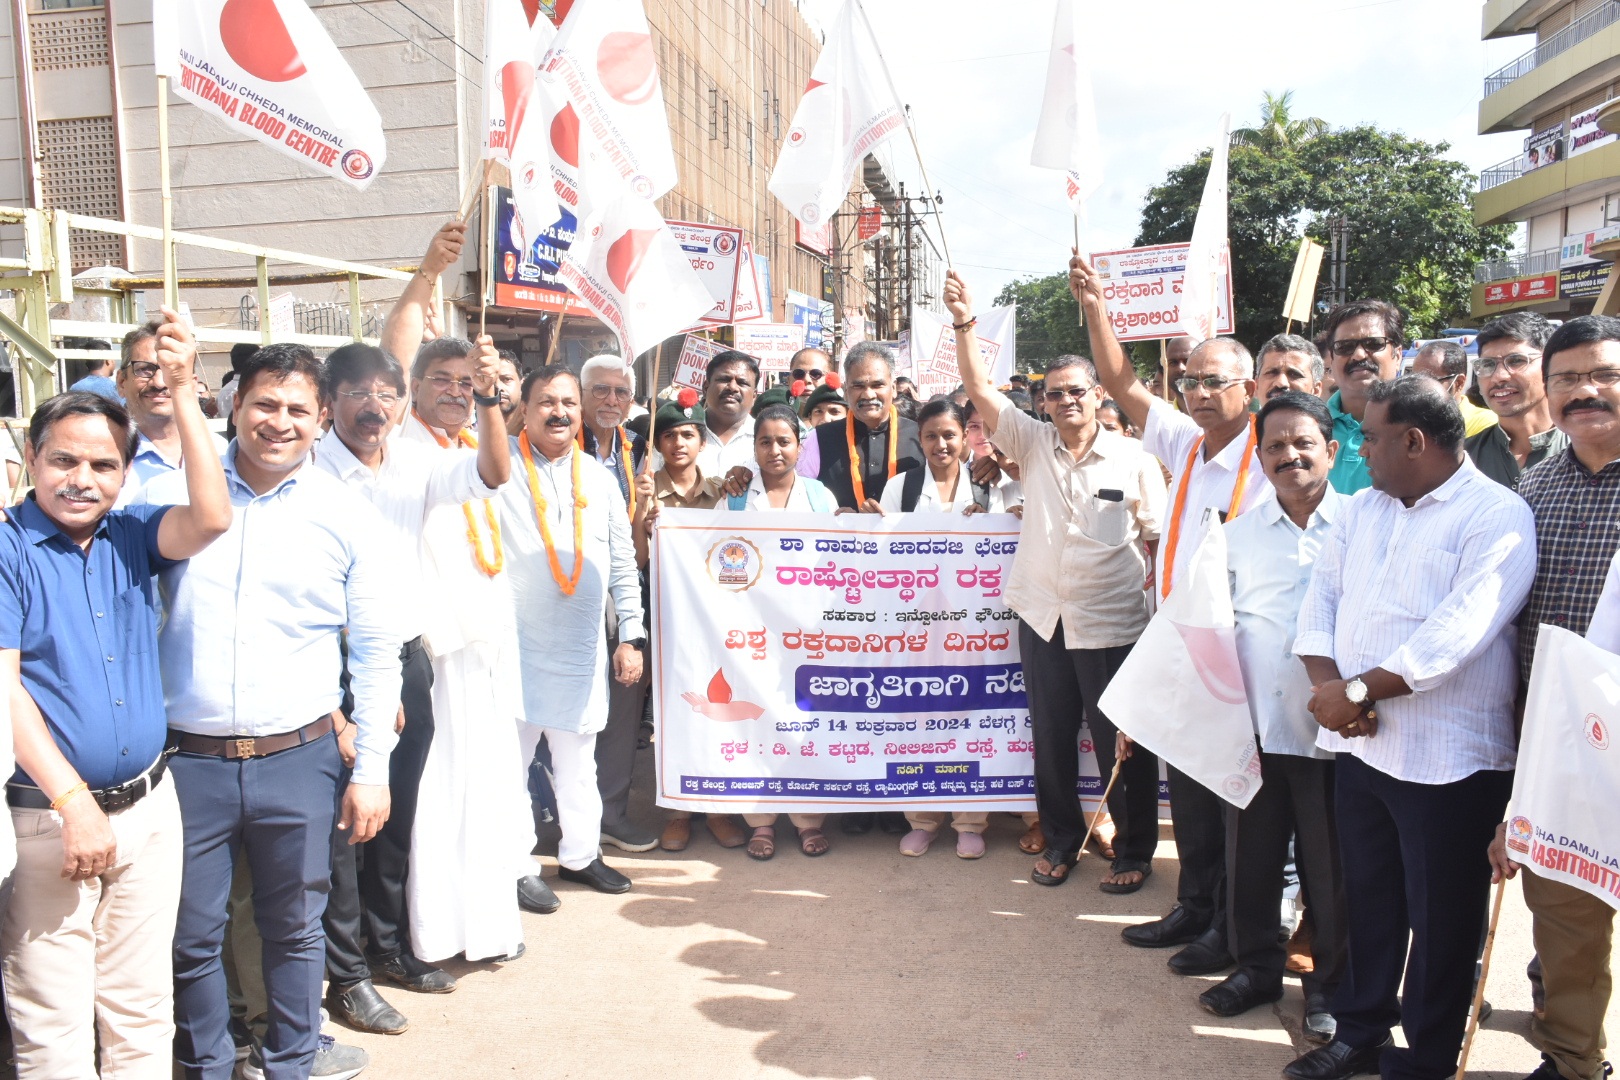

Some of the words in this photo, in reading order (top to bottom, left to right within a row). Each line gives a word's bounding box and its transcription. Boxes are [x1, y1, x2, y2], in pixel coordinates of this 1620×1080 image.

[180, 63, 240, 118] ROTTHANA
[239, 102, 287, 140] BLOOD
[285, 129, 340, 168] CENTRE
[195, 59, 237, 92] JADAVJI
[239, 86, 285, 118] CHHEDA
[287, 112, 344, 149] MEMORIAL
[581, 102, 608, 140] BLOOD
[601, 138, 635, 180] CENTRE
[1103, 277, 1164, 304] ರಕ್ತದಾನ
[920, 372, 947, 384] DONATE
[780, 538, 804, 551] ಶಾ
[815, 536, 878, 555] ದಾಮಜಿ
[889, 537, 964, 555] ಜಾದವಜಿ
[776, 561, 939, 605] ರಾಷ್ಟ್ರೋತ್ಥಾನ
[956, 563, 1002, 597] ರಕ್ತ
[823, 608, 876, 622] ಸಹಕಾರ
[724, 625, 767, 660] ವಿಶ್ವ
[782, 626, 928, 660] ರಕ್ತದಾನಿಗಳ
[943, 628, 1010, 652] ದಿನದ
[809, 671, 969, 709] ಜಾಗೃತಿಗಾಗಿ
[775, 718, 820, 732] ಜೂನ್
[828, 719, 848, 732] 14
[855, 718, 917, 736] ಶುಕ್ರವಾರ
[925, 718, 972, 731] 2024
[979, 715, 1016, 735] ಬೆಳಗ್ಗೆ
[720, 739, 749, 763] ಸ್ಥಳ
[772, 741, 791, 756] ಡಿ.
[800, 741, 819, 757] ಜೆ.
[828, 740, 875, 763] ಕಟ್ಟಡ,
[966, 737, 998, 759] ರಸ್ತೆ,
[896, 764, 924, 775] ನಡಿಗೆ
[934, 764, 970, 774] ಮಾರ್ಗ
[685, 779, 699, 791] ರಕ್ತ
[1007, 779, 1024, 788] ಬಸ್
[1559, 836, 1599, 860] DAMJI
